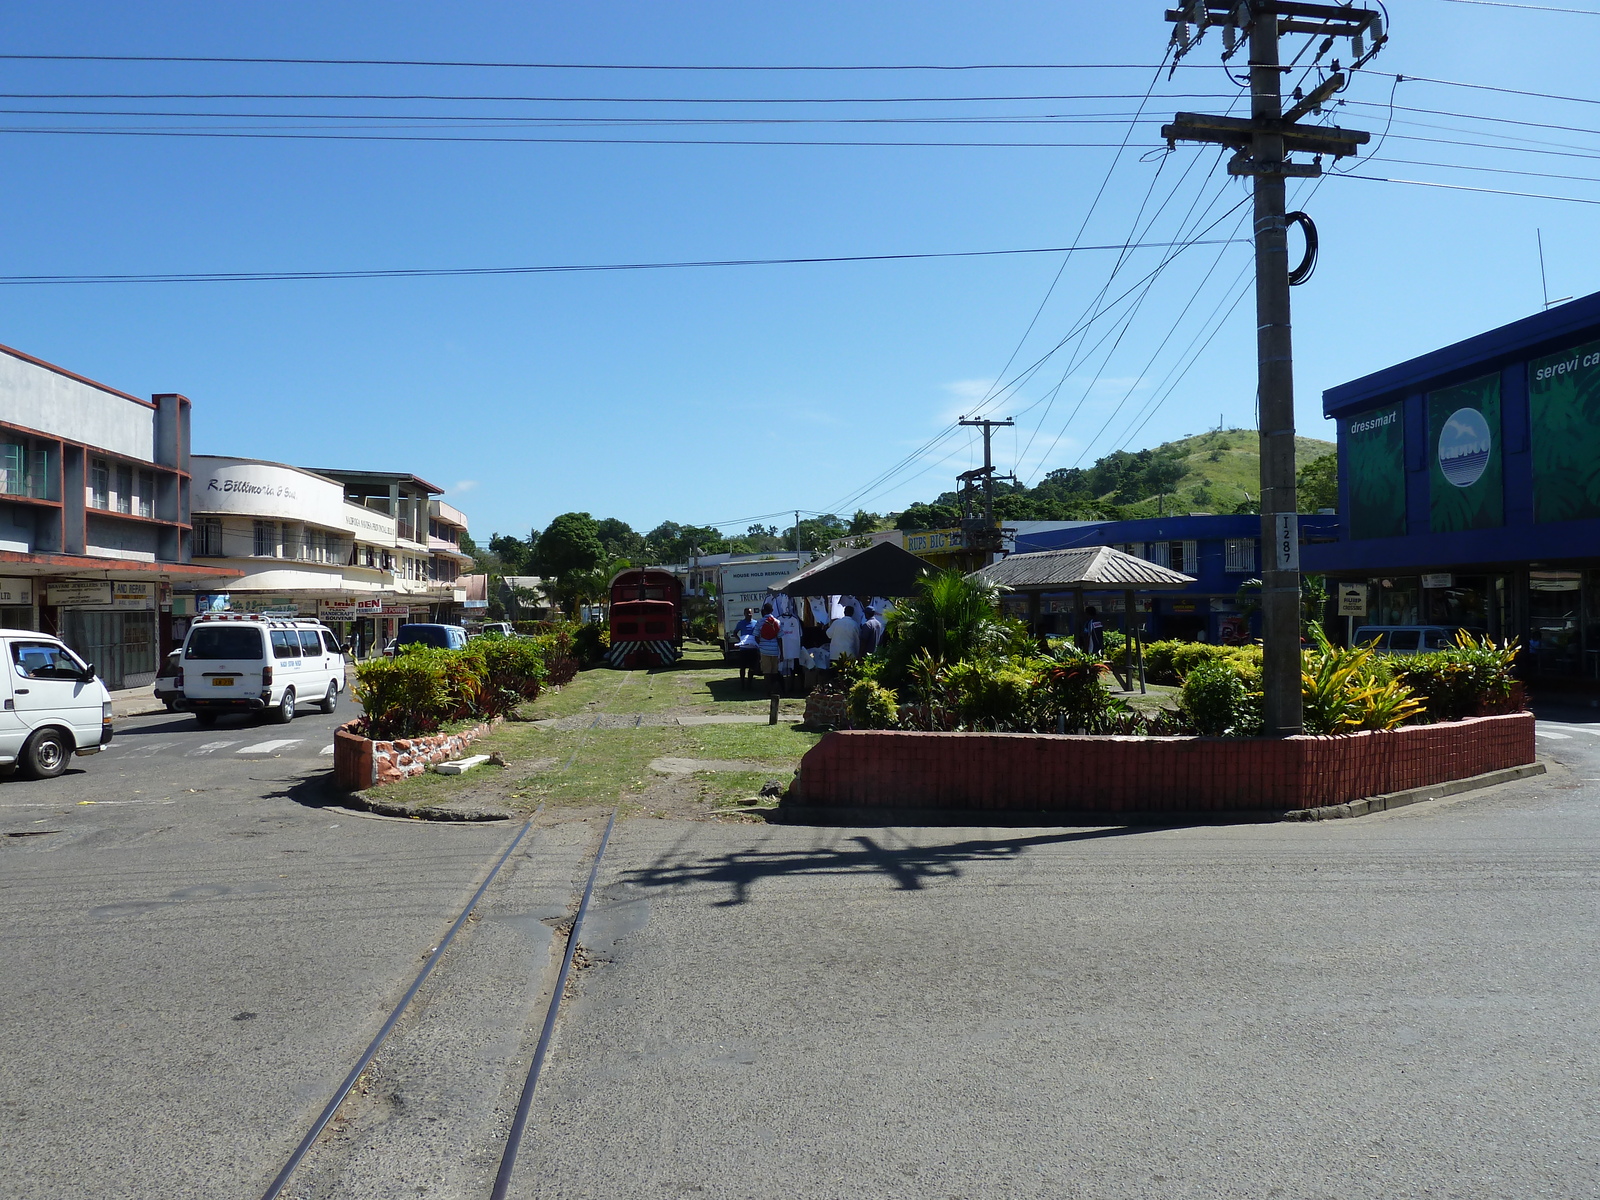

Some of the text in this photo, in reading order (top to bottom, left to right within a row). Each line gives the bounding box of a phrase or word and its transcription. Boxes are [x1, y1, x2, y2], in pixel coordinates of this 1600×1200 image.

[1536, 355, 1579, 380] serevi
[1351, 410, 1396, 434] dressmart
[908, 536, 927, 551] RUPS
[930, 533, 945, 548] BIG
[116, 584, 147, 593] AND REPAIR
[358, 599, 381, 608] DEN
[740, 593, 758, 602] TRUCK
